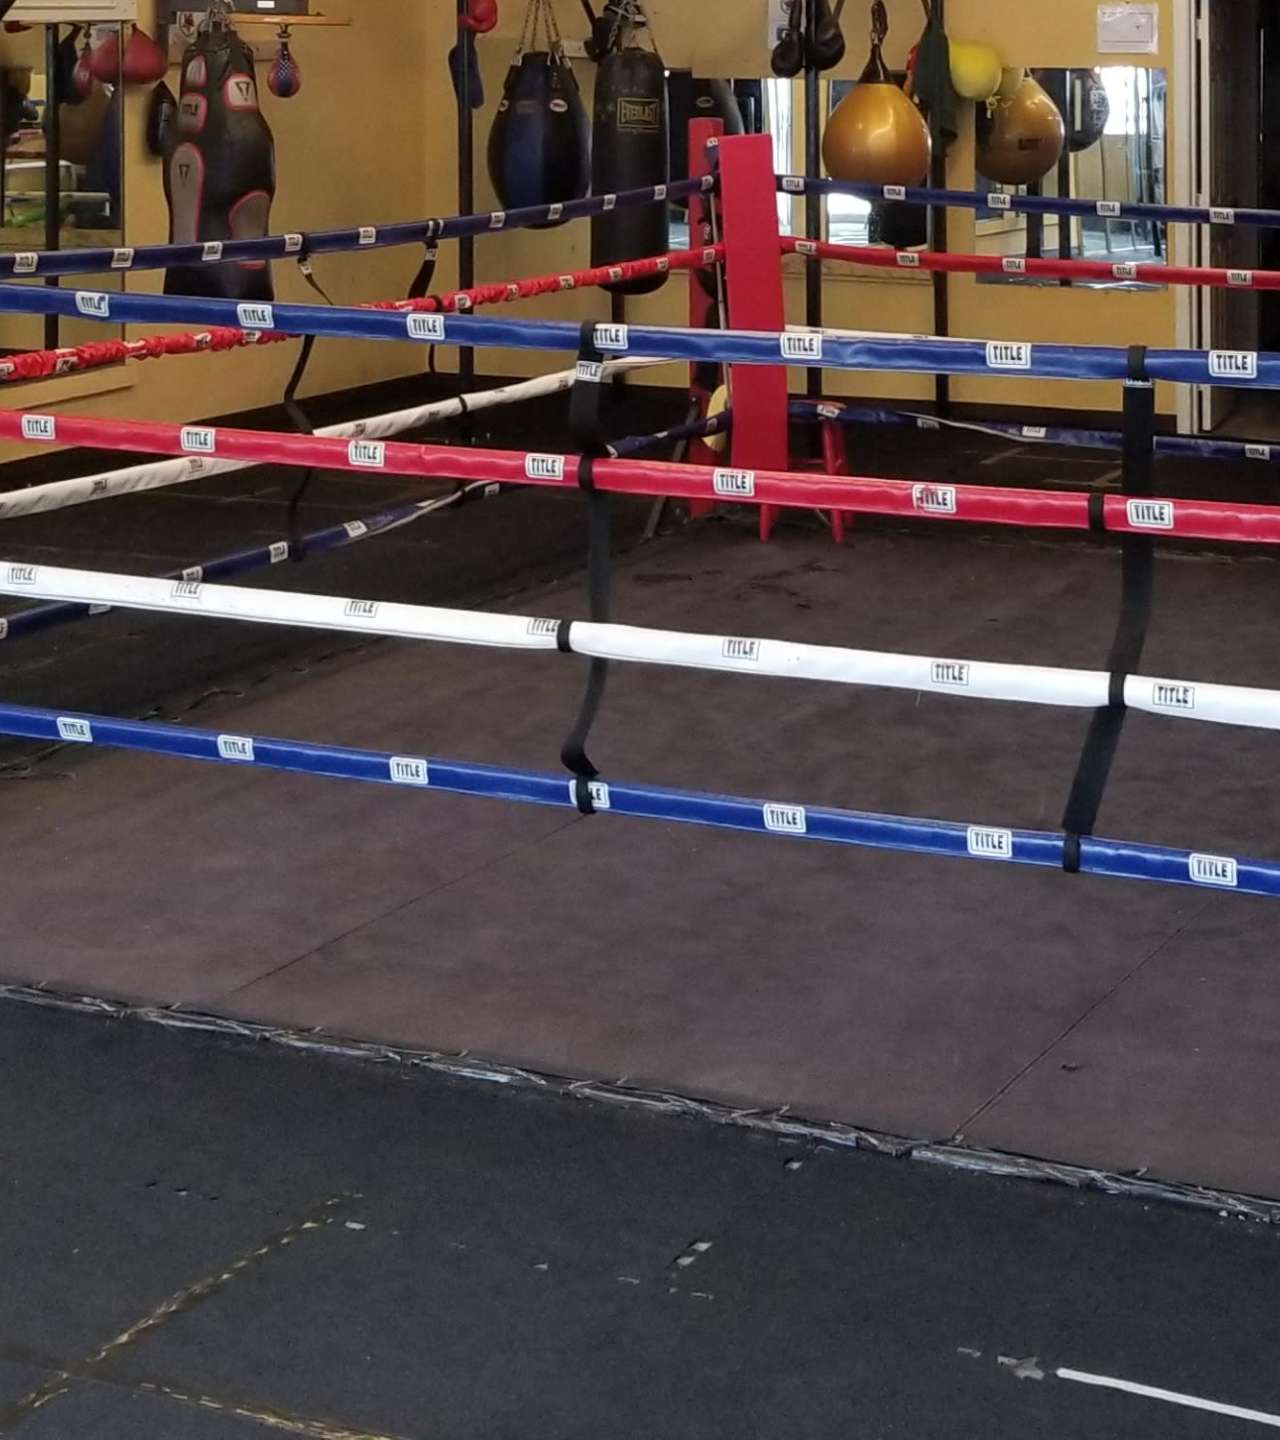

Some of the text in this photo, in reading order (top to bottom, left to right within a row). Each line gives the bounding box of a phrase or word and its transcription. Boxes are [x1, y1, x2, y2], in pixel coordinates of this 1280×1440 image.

[621, 102, 657, 123] EVERLAST
[81, 295, 103, 312] TITLE
[243, 309, 267, 324] TITLE
[412, 319, 437, 334] TITLE
[593, 328, 621, 344] TITLE
[787, 336, 814, 352] TITLE
[991, 346, 1022, 361] TITLE
[1216, 355, 1248, 371] TITLE
[27, 420, 49, 434] TITLE
[186, 432, 209, 446] TITLE
[353, 445, 377, 460] TITLE
[531, 459, 557, 475] TITLE
[720, 474, 747, 489] TITLE
[918, 490, 948, 506] TITLE
[1134, 505, 1165, 521] TITLE
[11, 567, 33, 581] TITLE
[176, 581, 199, 595] TITLE
[349, 601, 374, 613] TITLE
[532, 618, 558, 633] TITLE
[727, 640, 755, 655] TITLE
[935, 663, 964, 681] TITLE
[1158, 687, 1189, 704] TITLE
[63, 722, 85, 736] TITLE
[224, 740, 247, 755] TITLE
[396, 762, 420, 777] TITLE
[770, 809, 797, 825] TITLE
[974, 833, 1004, 850] TITLE
[1196, 860, 1227, 878] TITLE
